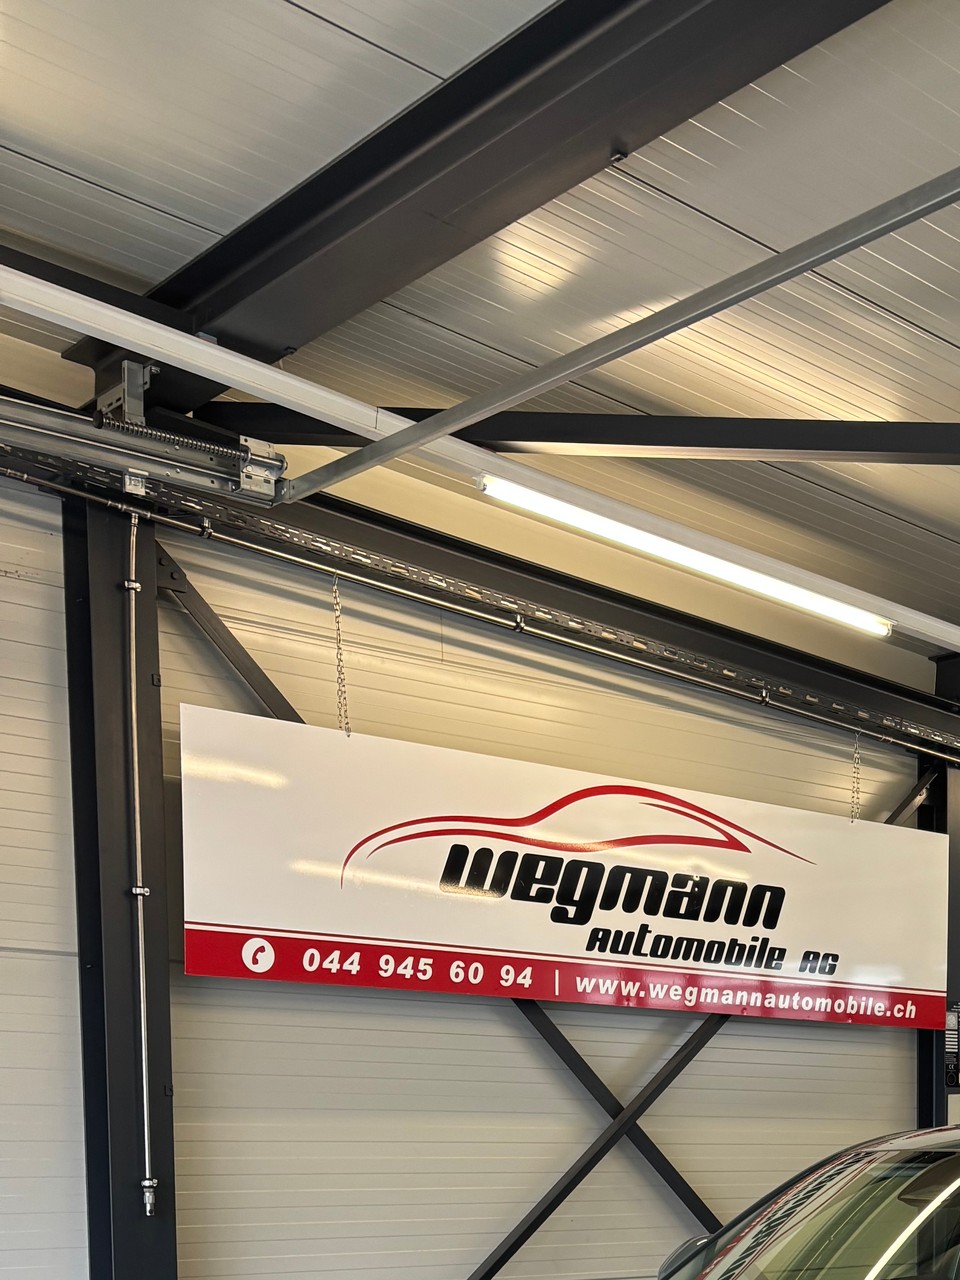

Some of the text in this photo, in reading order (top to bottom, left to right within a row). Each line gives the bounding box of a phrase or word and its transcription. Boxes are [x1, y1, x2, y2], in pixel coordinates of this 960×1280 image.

[302, 948, 533, 988] 044 945 60 94
[798, 950, 840, 976] AG
[575, 976, 917, 1019] www.wegmannautomobile.ch
